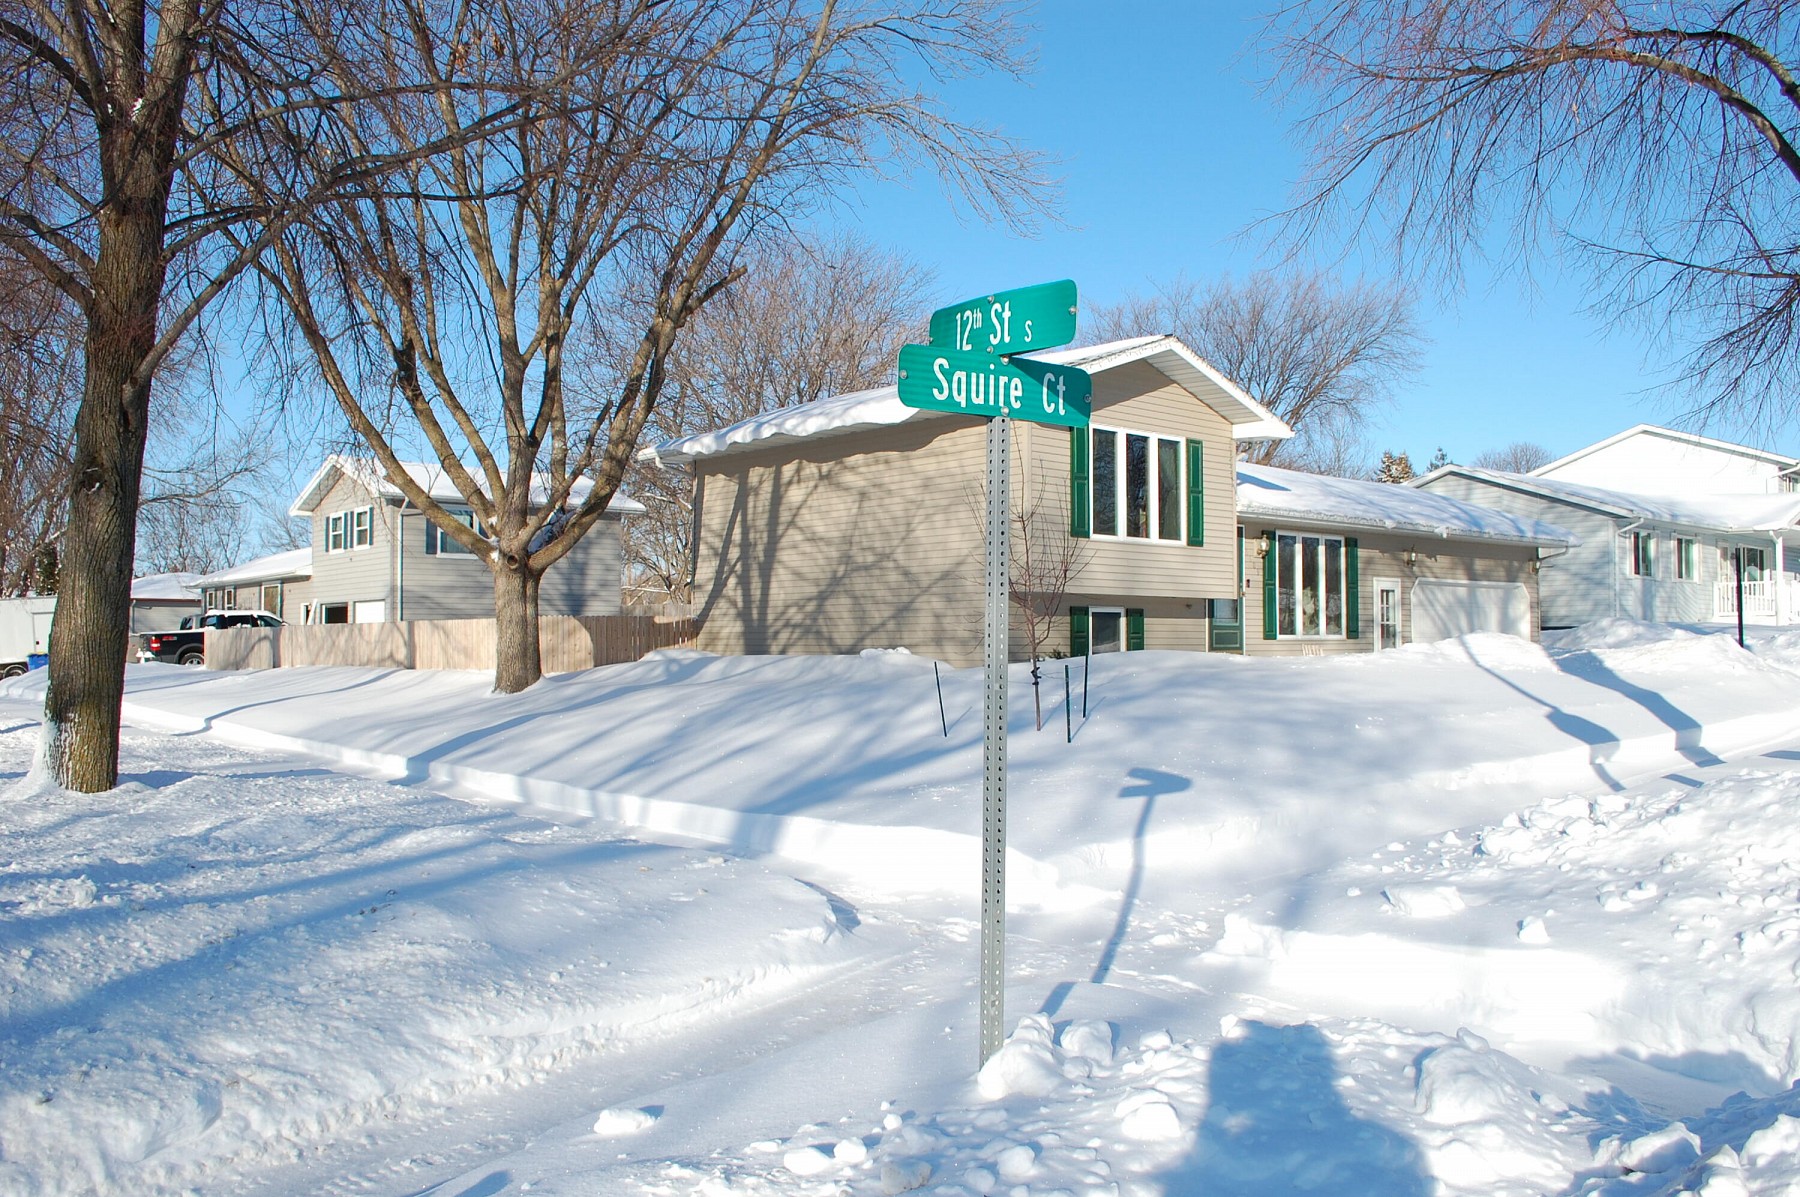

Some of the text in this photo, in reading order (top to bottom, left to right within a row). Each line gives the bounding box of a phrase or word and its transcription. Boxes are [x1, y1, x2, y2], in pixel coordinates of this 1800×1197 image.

[956, 308, 982, 351] 12th
[989, 300, 1011, 345] St
[932, 357, 1066, 416] Squire Ct
